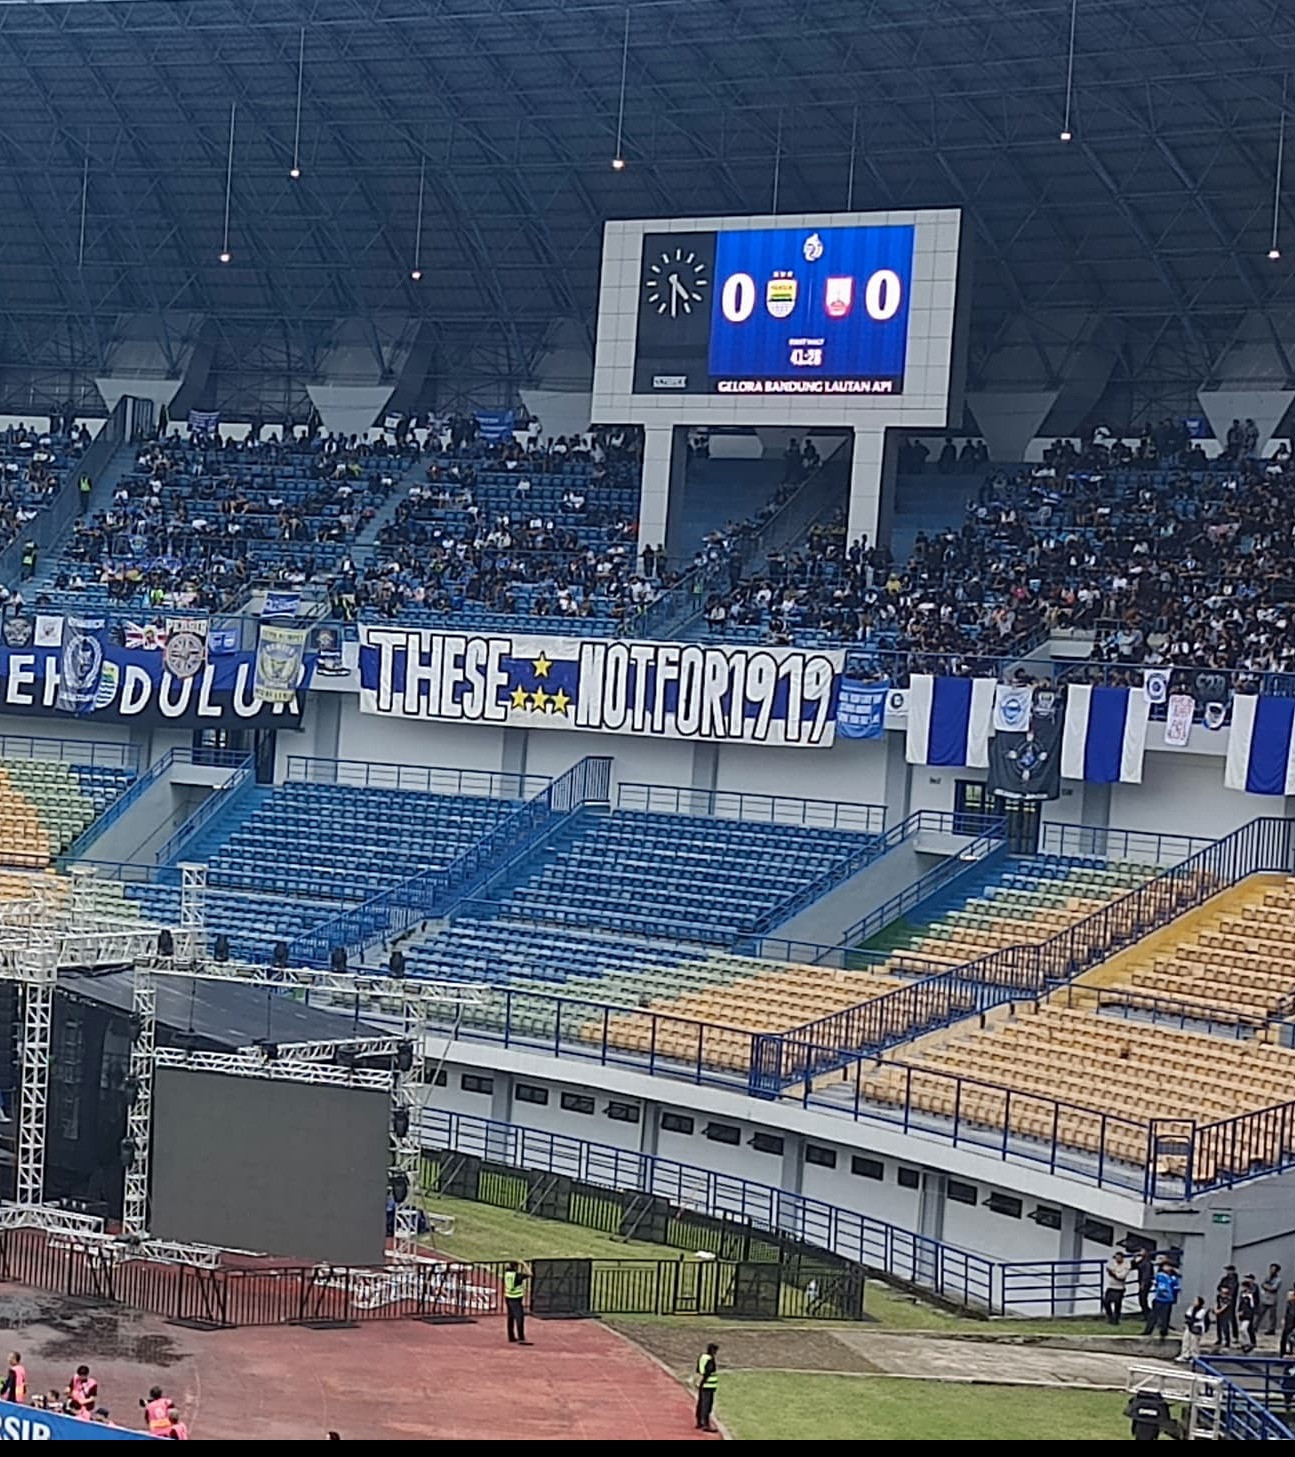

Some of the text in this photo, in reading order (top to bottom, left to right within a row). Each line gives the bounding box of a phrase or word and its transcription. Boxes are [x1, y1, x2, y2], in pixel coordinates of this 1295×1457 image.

[722, 269, 902, 323] 0 0
[718, 380, 892, 393] GELORA BANDUNG LAUTAN API
[368, 629, 834, 744] THESE NOTFOR1919
